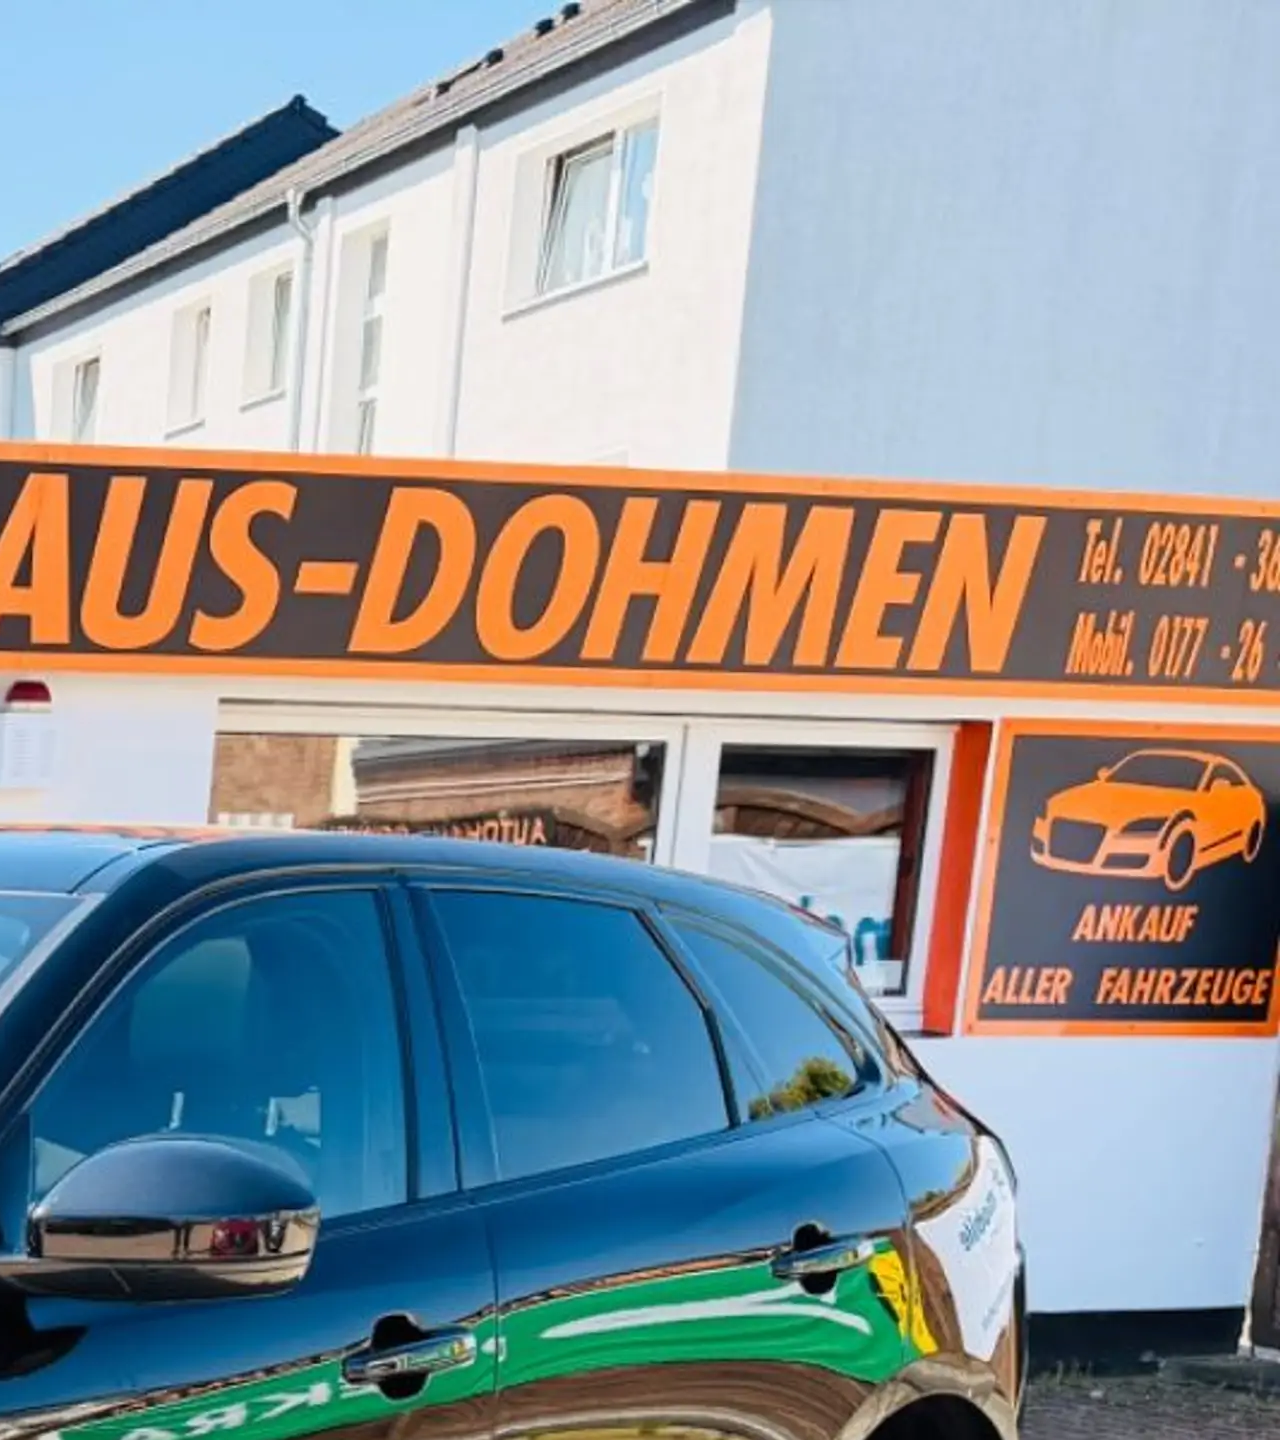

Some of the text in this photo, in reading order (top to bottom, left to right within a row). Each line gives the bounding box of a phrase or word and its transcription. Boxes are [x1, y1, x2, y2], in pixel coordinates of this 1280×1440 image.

[1078, 518, 1123, 585] Tel.
[1139, 522, 1219, 587] 02841
[1065, 610, 1135, 676] Mobil.
[1148, 615, 1209, 678] 0177
[1232, 618, 1268, 682] 26
[1073, 905, 1199, 943] ANKAUF
[983, 966, 1272, 1006] ALLER FAHRZEUGE
